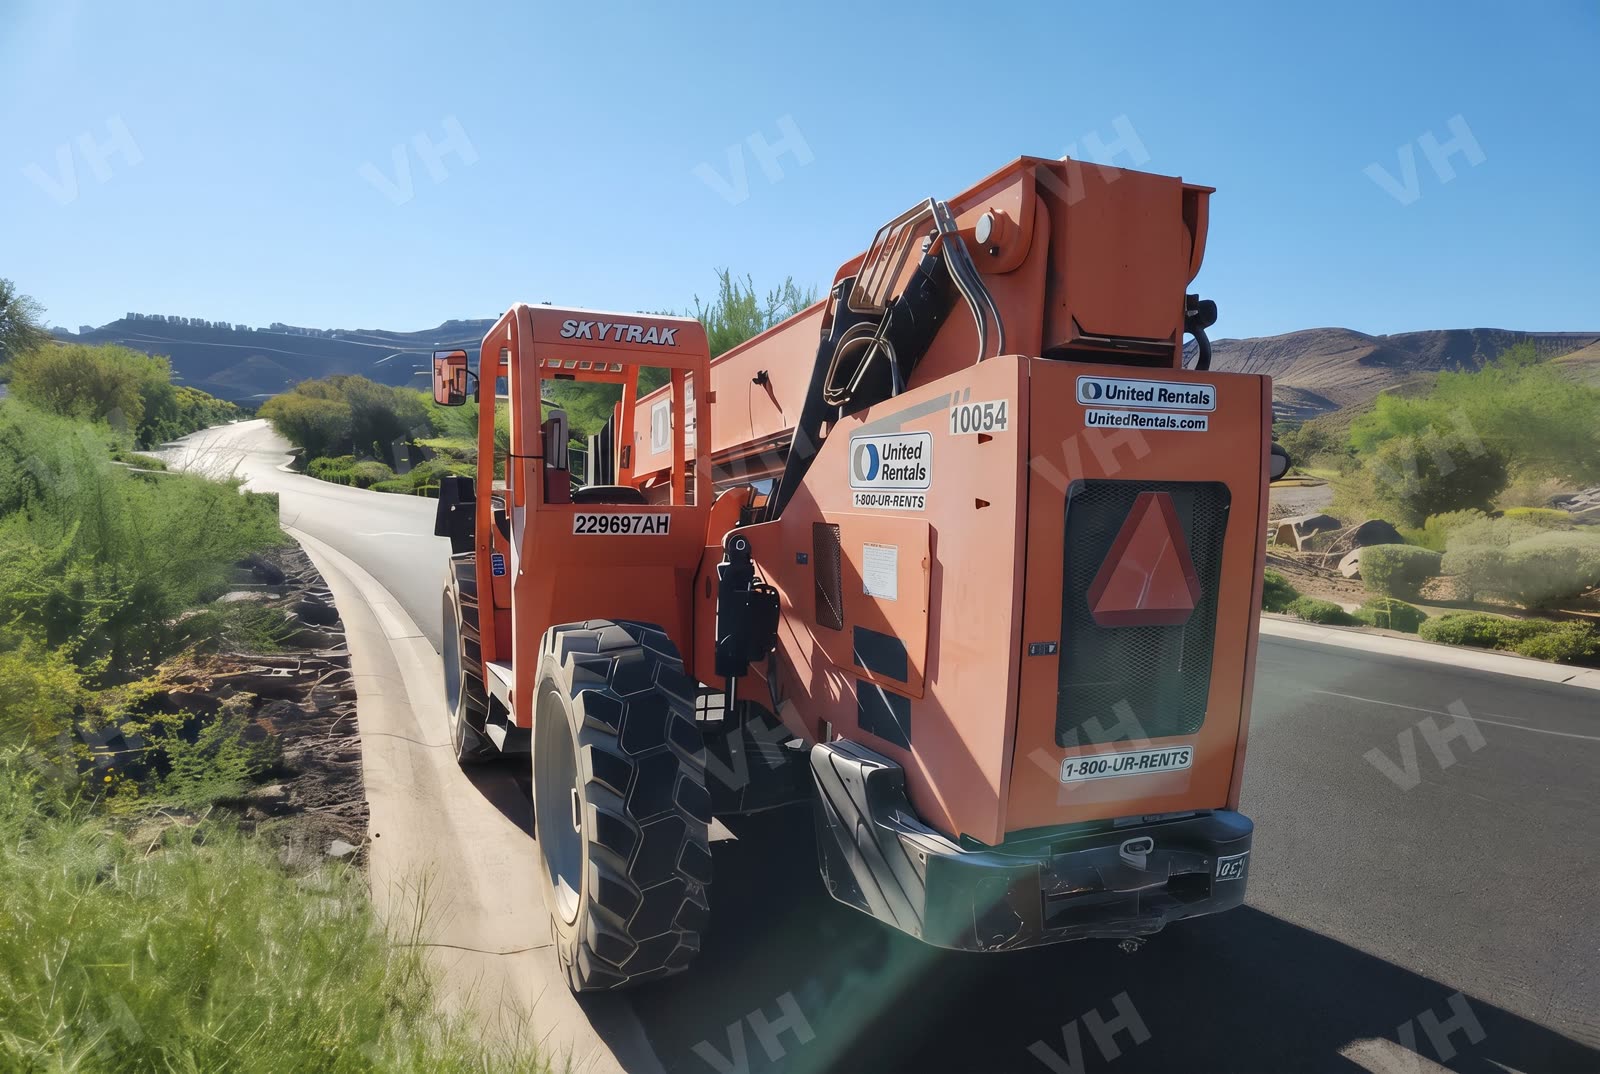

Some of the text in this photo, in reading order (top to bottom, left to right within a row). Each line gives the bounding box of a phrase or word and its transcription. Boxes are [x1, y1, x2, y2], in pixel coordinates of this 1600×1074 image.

[559, 319, 679, 346] SKYTRAK
[1105, 384, 1210, 405] United Rentals
[951, 401, 1007, 434] 10054
[1087, 412, 1206, 429] UnitedRentals.com
[882, 441, 923, 461] United
[881, 462, 926, 481] Rentals
[855, 493, 924, 509] 1-800-UR-RENTS
[574, 515, 669, 534] 229697AH
[1065, 750, 1190, 777] 1-800-UR-RENTS
